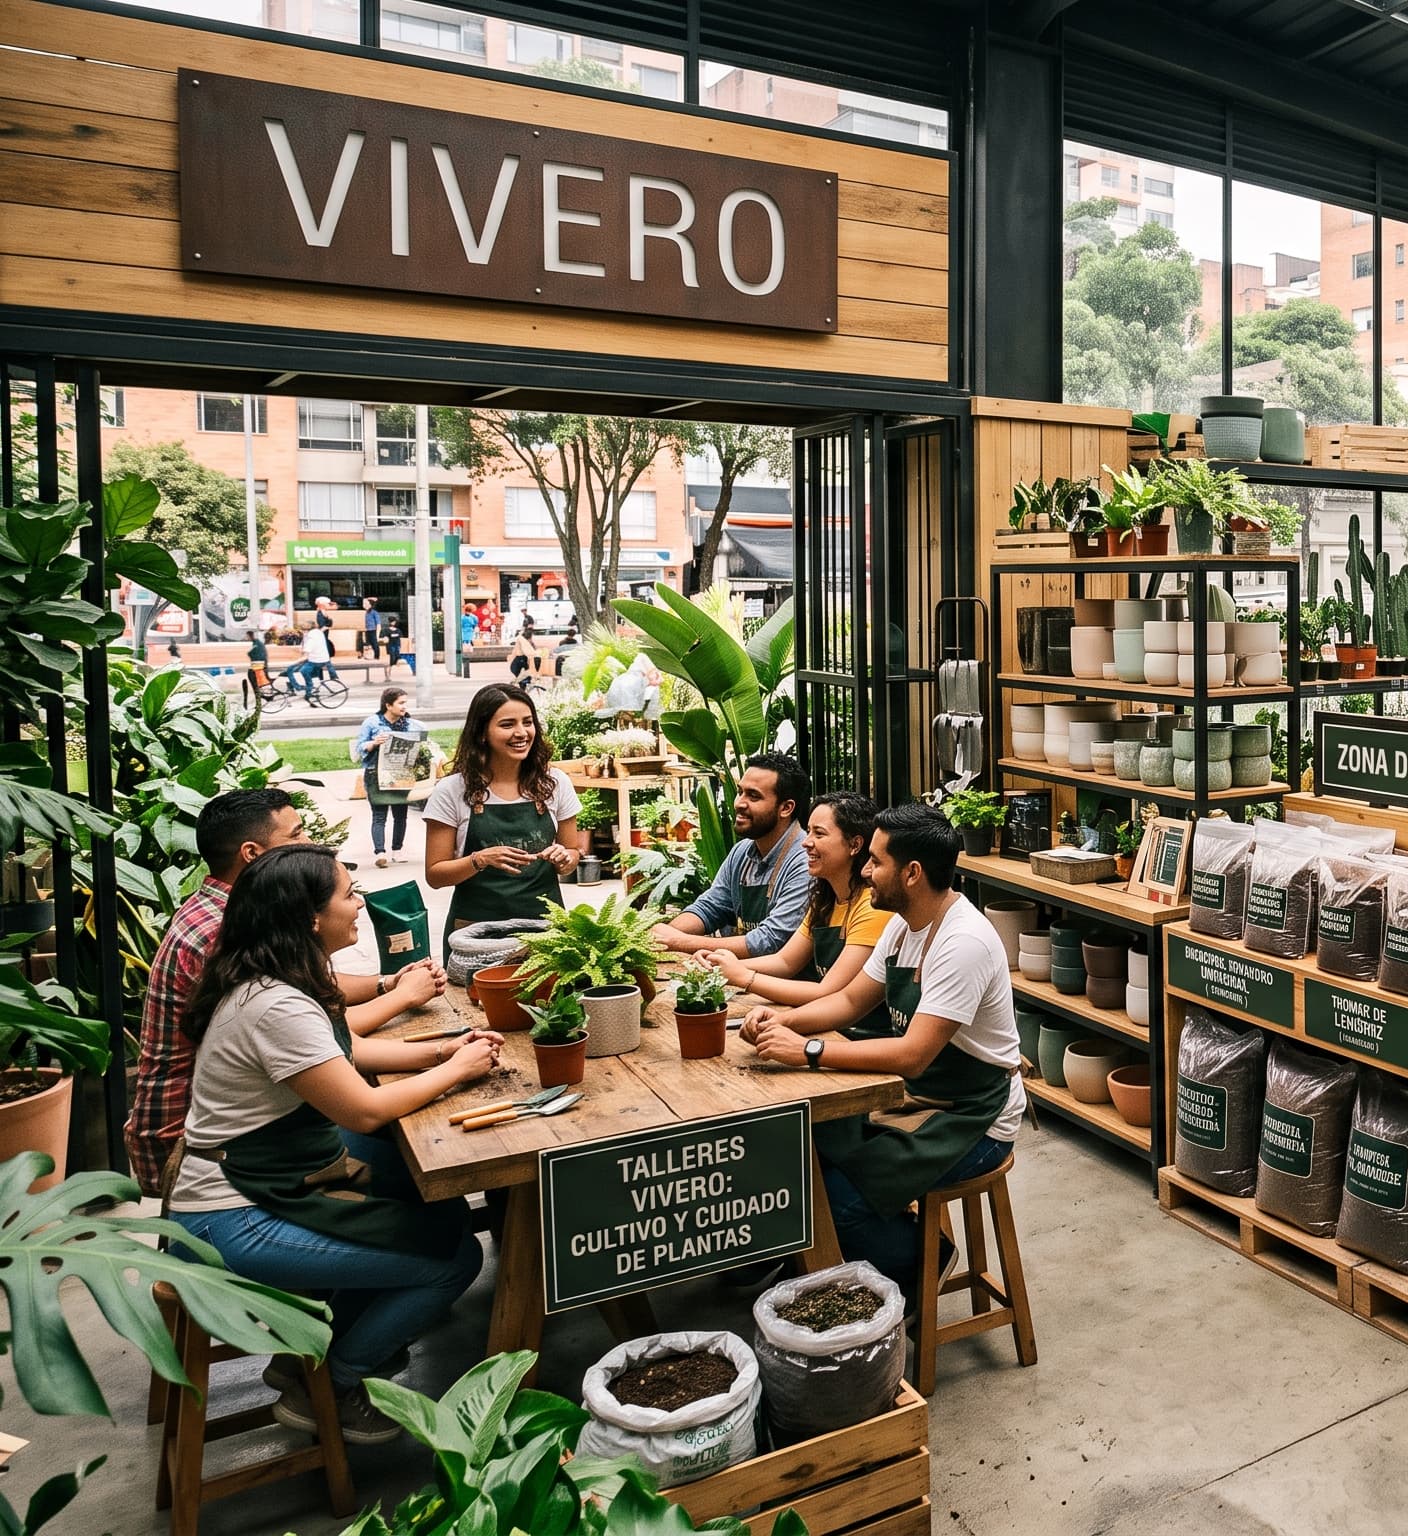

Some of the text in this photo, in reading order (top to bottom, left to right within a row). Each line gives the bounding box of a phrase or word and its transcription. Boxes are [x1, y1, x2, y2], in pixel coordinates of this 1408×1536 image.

[263, 118, 786, 297] VIVERO
[1337, 743, 1389, 777] ZONA
[1373, 1007, 1387, 1024] DE
[617, 1135, 746, 1183] TALLERES
[631, 1171, 733, 1213] VIVERO:
[571, 1188, 791, 1257] CULTIVO Y CUIDADO
[616, 1224, 752, 1275] DE PLANTAS
